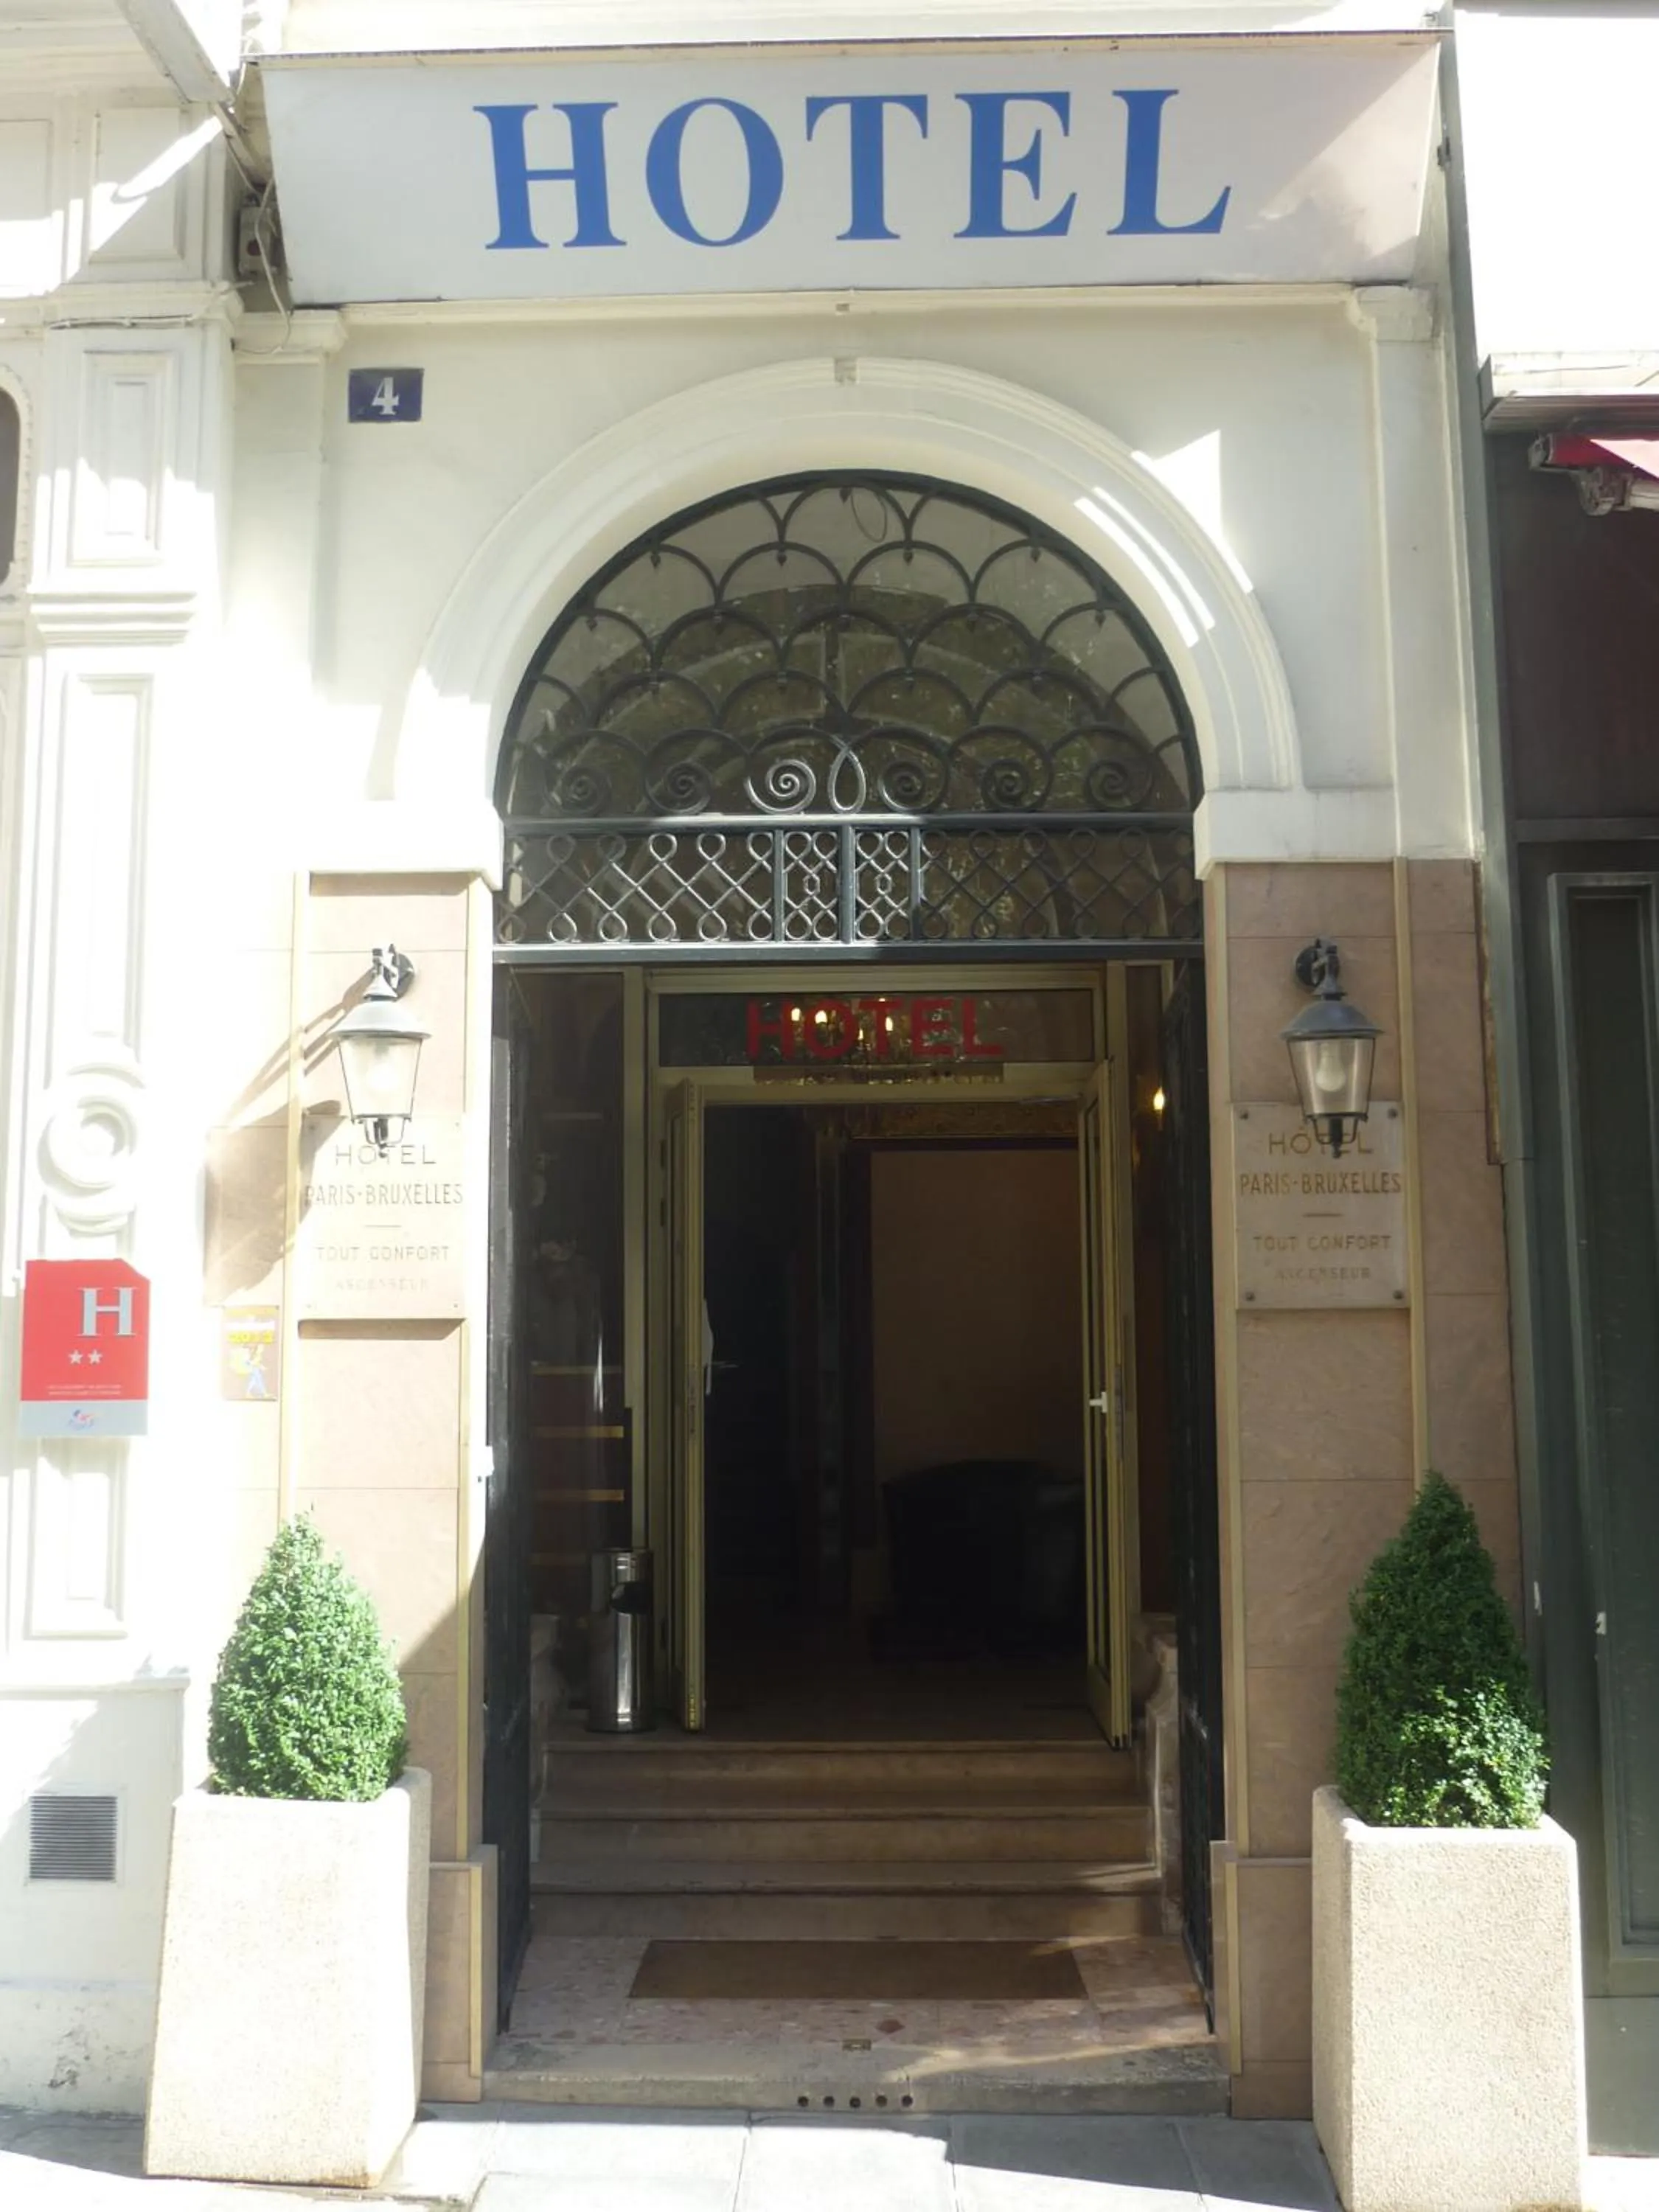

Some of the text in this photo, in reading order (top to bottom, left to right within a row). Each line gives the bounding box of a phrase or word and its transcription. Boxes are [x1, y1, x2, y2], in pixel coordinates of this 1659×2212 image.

[473, 88, 1231, 249] HOTEL
[372, 377, 399, 415] 4
[746, 998, 1004, 1060] HOTEL
[315, 1244, 451, 1262] TOUT CONFORT
[1253, 1235, 1391, 1251] TOUT CONFORT
[76, 1287, 139, 1337] H
